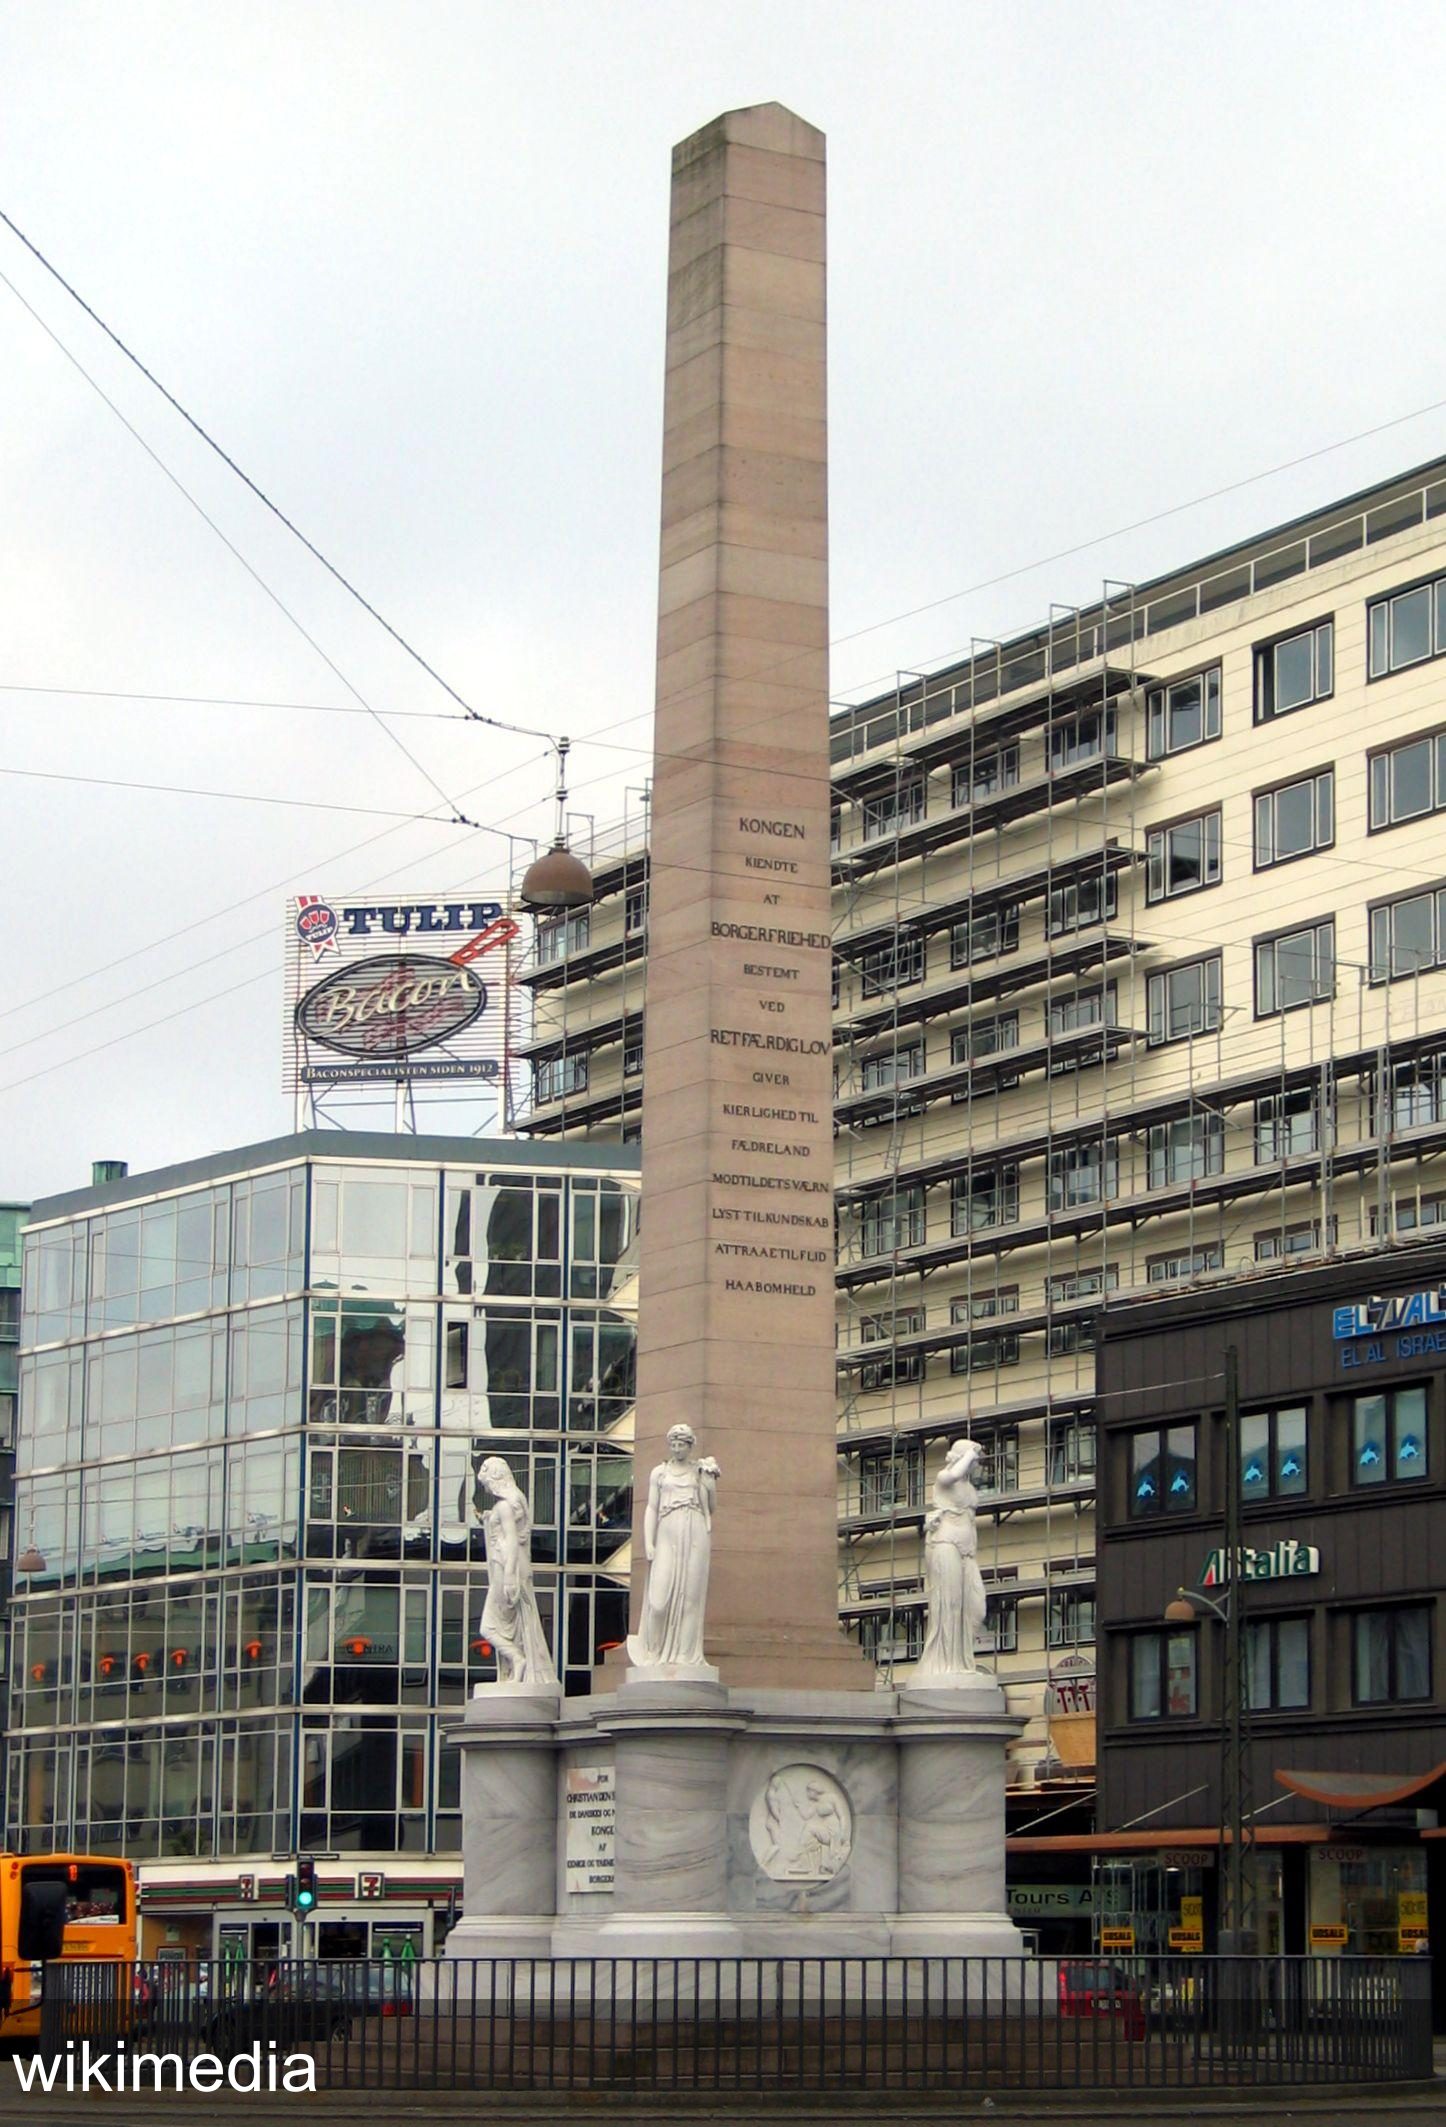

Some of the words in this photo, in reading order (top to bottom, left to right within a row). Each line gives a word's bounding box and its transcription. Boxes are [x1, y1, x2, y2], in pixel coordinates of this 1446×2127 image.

[739, 816, 805, 839] KONGEN
[745, 856, 798, 874] KIENDTE
[763, 893, 780, 905] AT
[343, 902, 503, 935] TULIP
[711, 921, 831, 949] BORGERFRIEHED
[743, 963, 800, 980] BESTEMT
[307, 968, 482, 1038] Bacon
[759, 1000, 785, 1013] VED
[430, 1064, 465, 1075] SIDEN
[469, 1063, 493, 1075] 1912
[752, 1071, 790, 1086] GIVER
[723, 1103, 797, 1123] KIERLIGHED
[798, 1111, 819, 1124] TIL
[731, 1138, 811, 1158] FÆDRELAND
[1342, 1346, 1362, 1368] EL
[1367, 1342, 1386, 1363] AL
[1165, 1852, 1208, 1866] SCOOP
[1319, 1848, 1364, 1860] SCOOP
[1006, 1888, 1069, 1905] Tours
